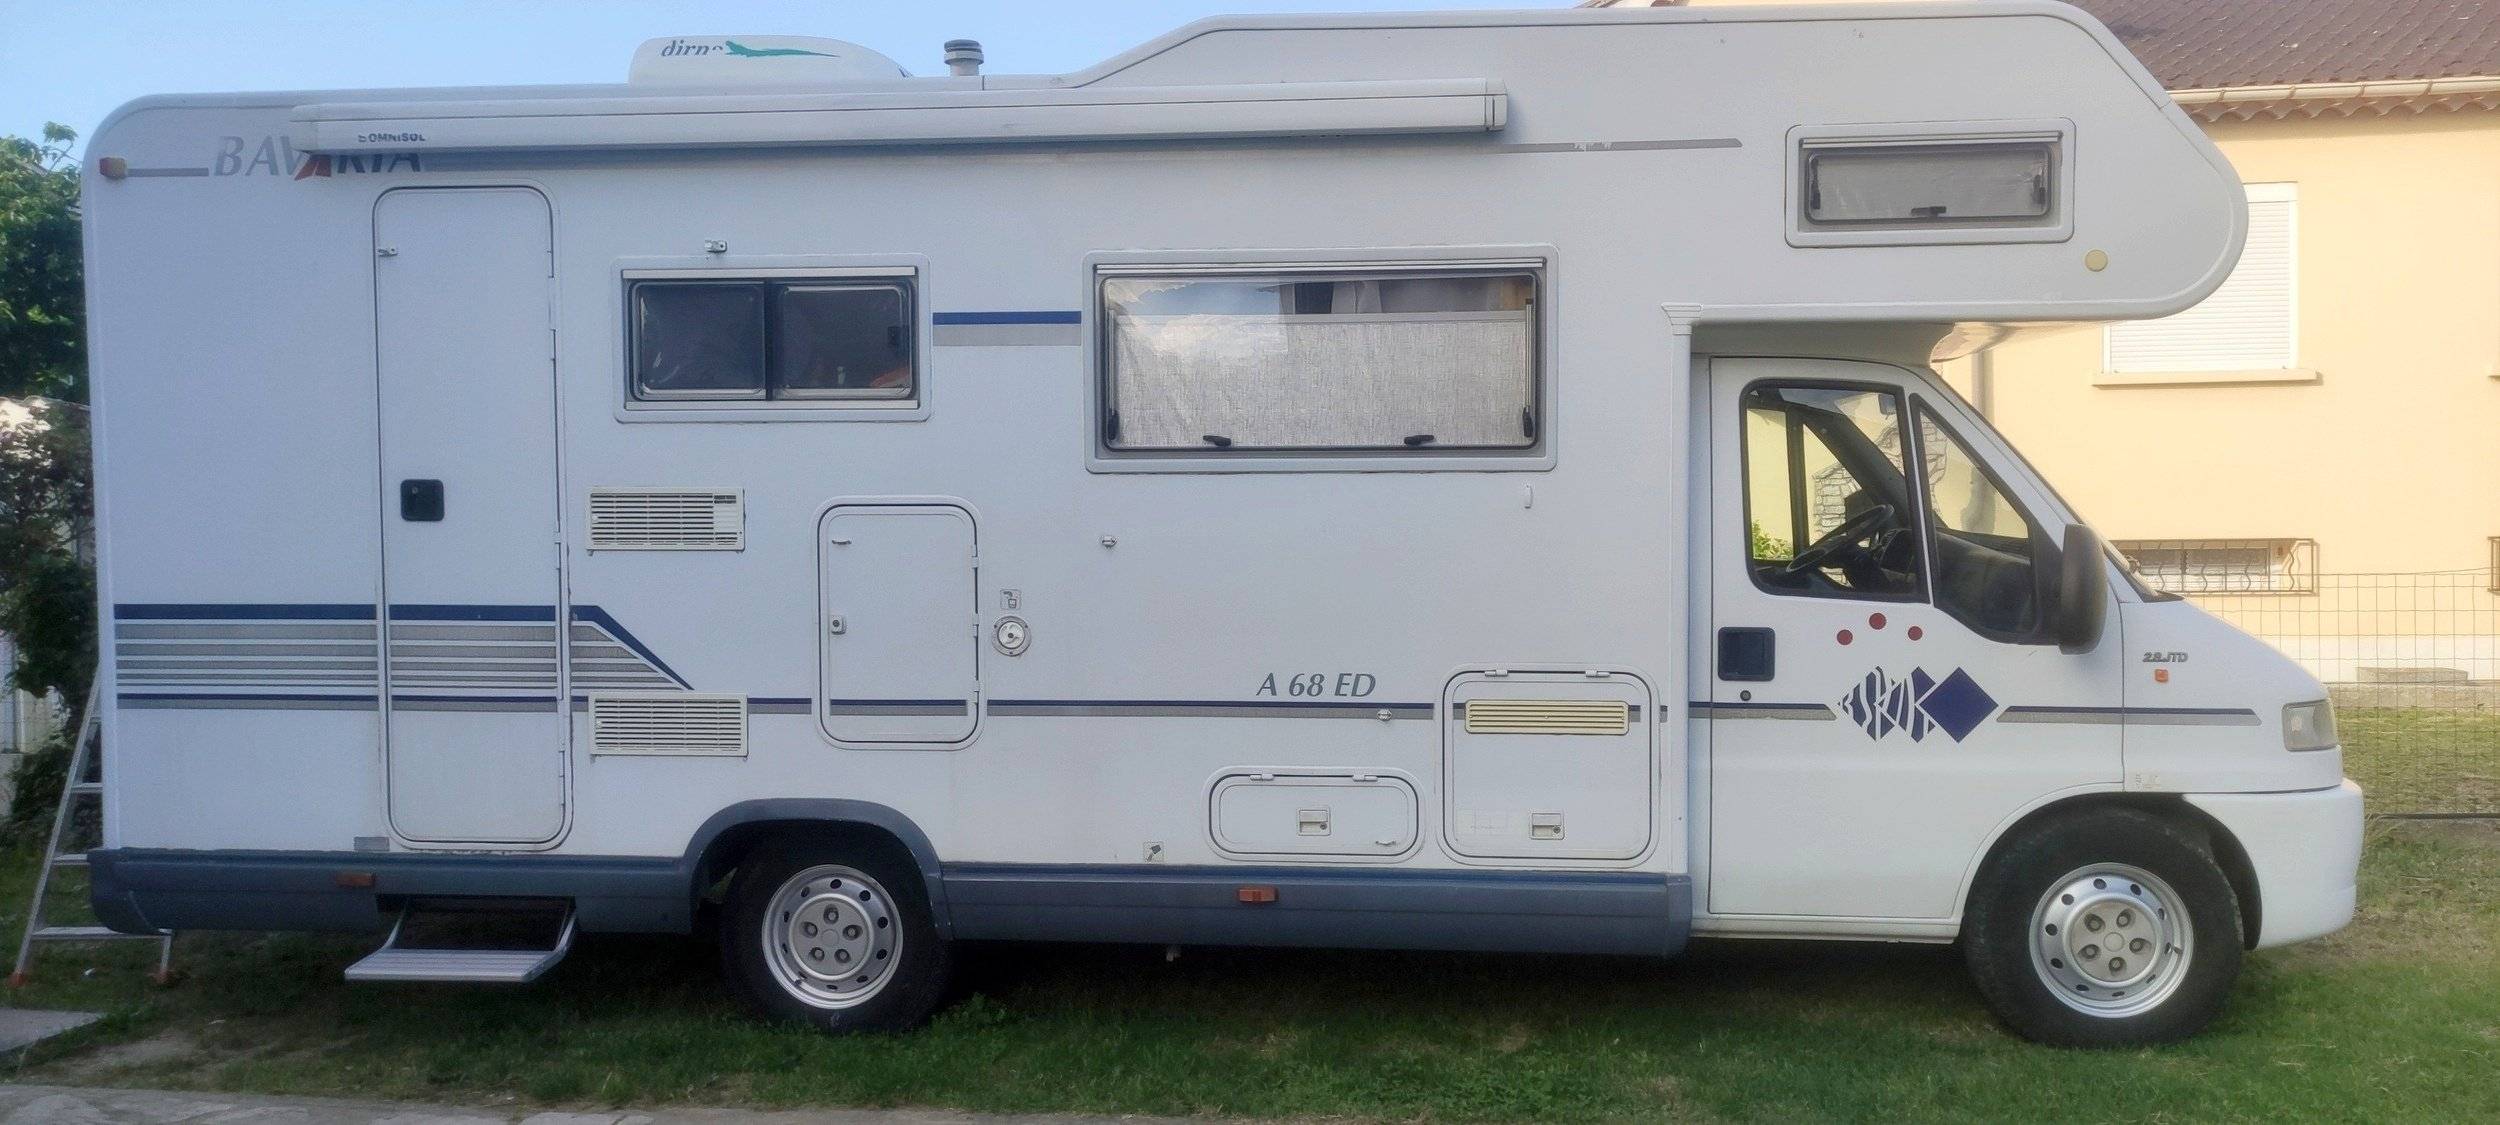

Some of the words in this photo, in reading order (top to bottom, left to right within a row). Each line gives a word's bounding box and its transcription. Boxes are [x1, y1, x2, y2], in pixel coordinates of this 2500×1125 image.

[1255, 672, 1278, 697] A
[1288, 673, 1326, 698] 68
[1334, 672, 1377, 698] ED
